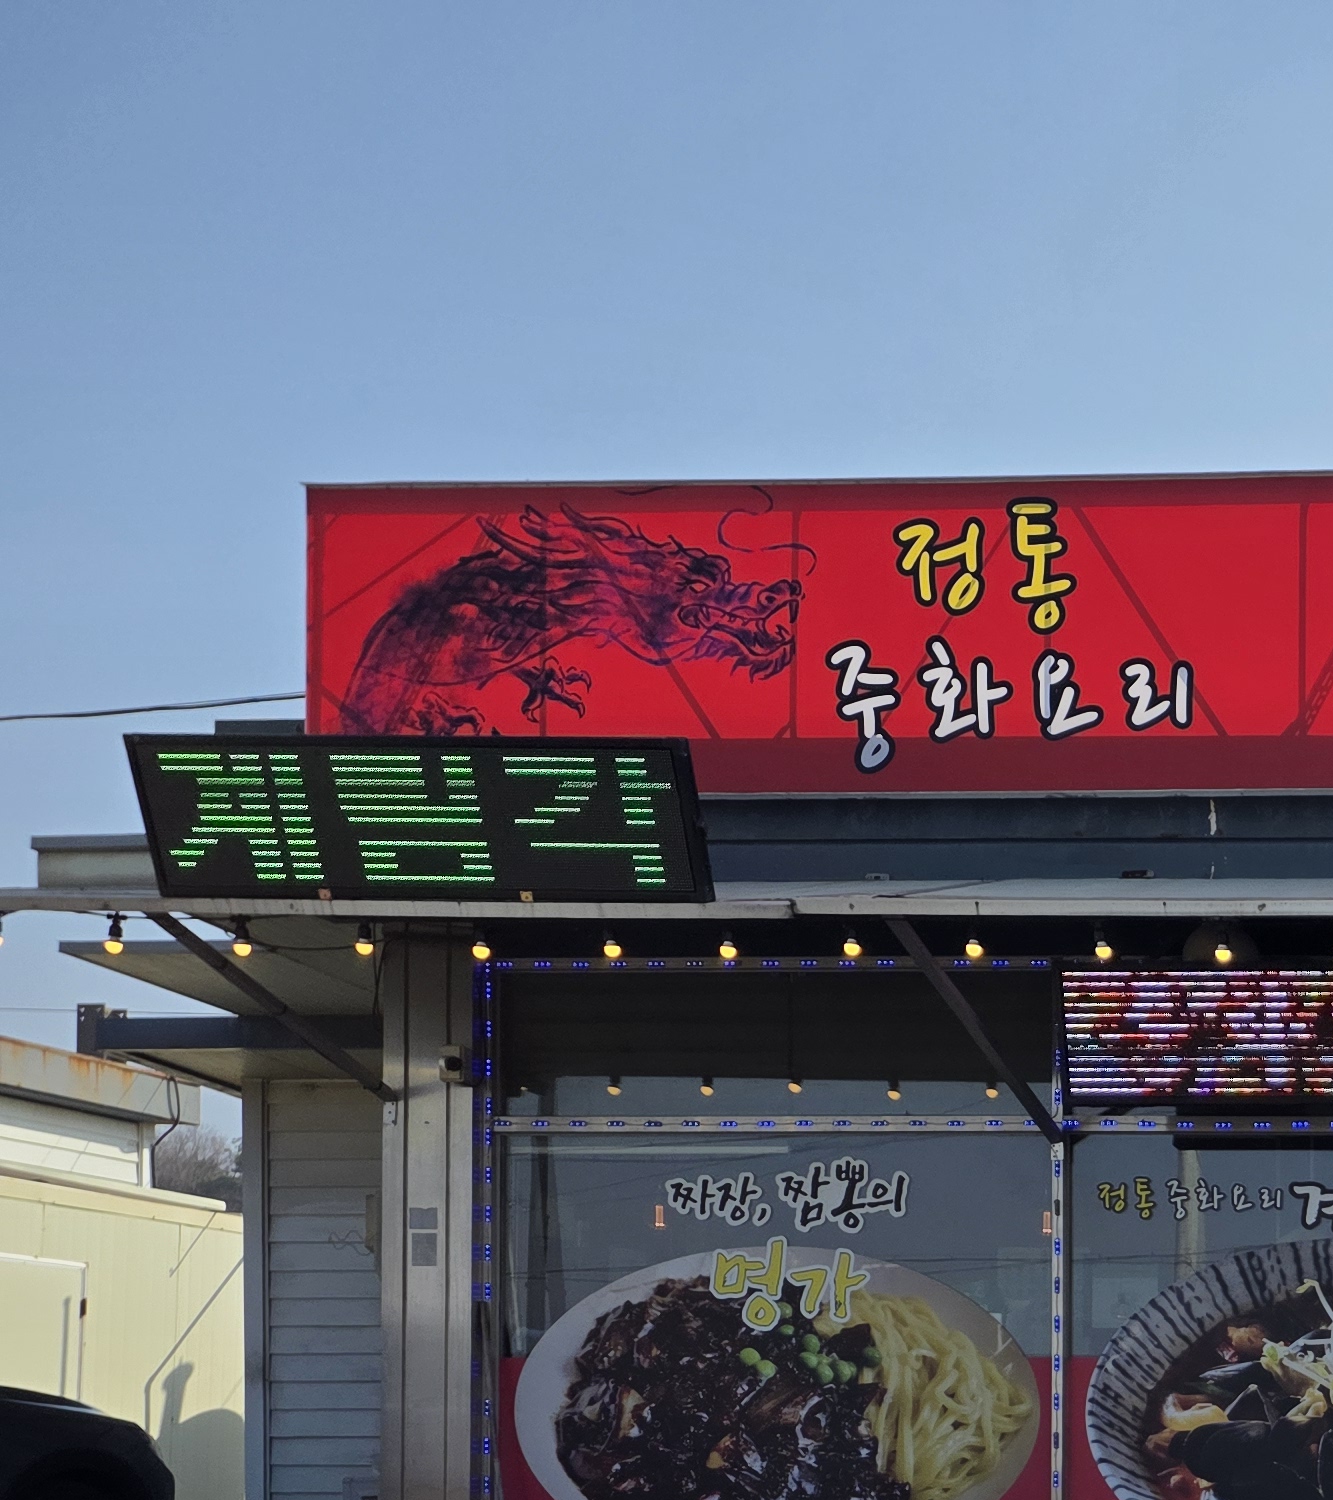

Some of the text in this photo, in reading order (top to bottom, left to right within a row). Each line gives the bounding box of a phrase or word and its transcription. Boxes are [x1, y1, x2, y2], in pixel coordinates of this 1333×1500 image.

[896, 501, 1075, 630] 정통
[828, 637, 1196, 770] 중화요리
[156, 753, 672, 883] 계림각
[666, 1157, 910, 1232] 짜장, 짬뽕의
[1097, 1176, 1157, 1220] 정통
[1166, 1178, 1284, 1220] 중화요리
[710, 1236, 870, 1332] 명가
